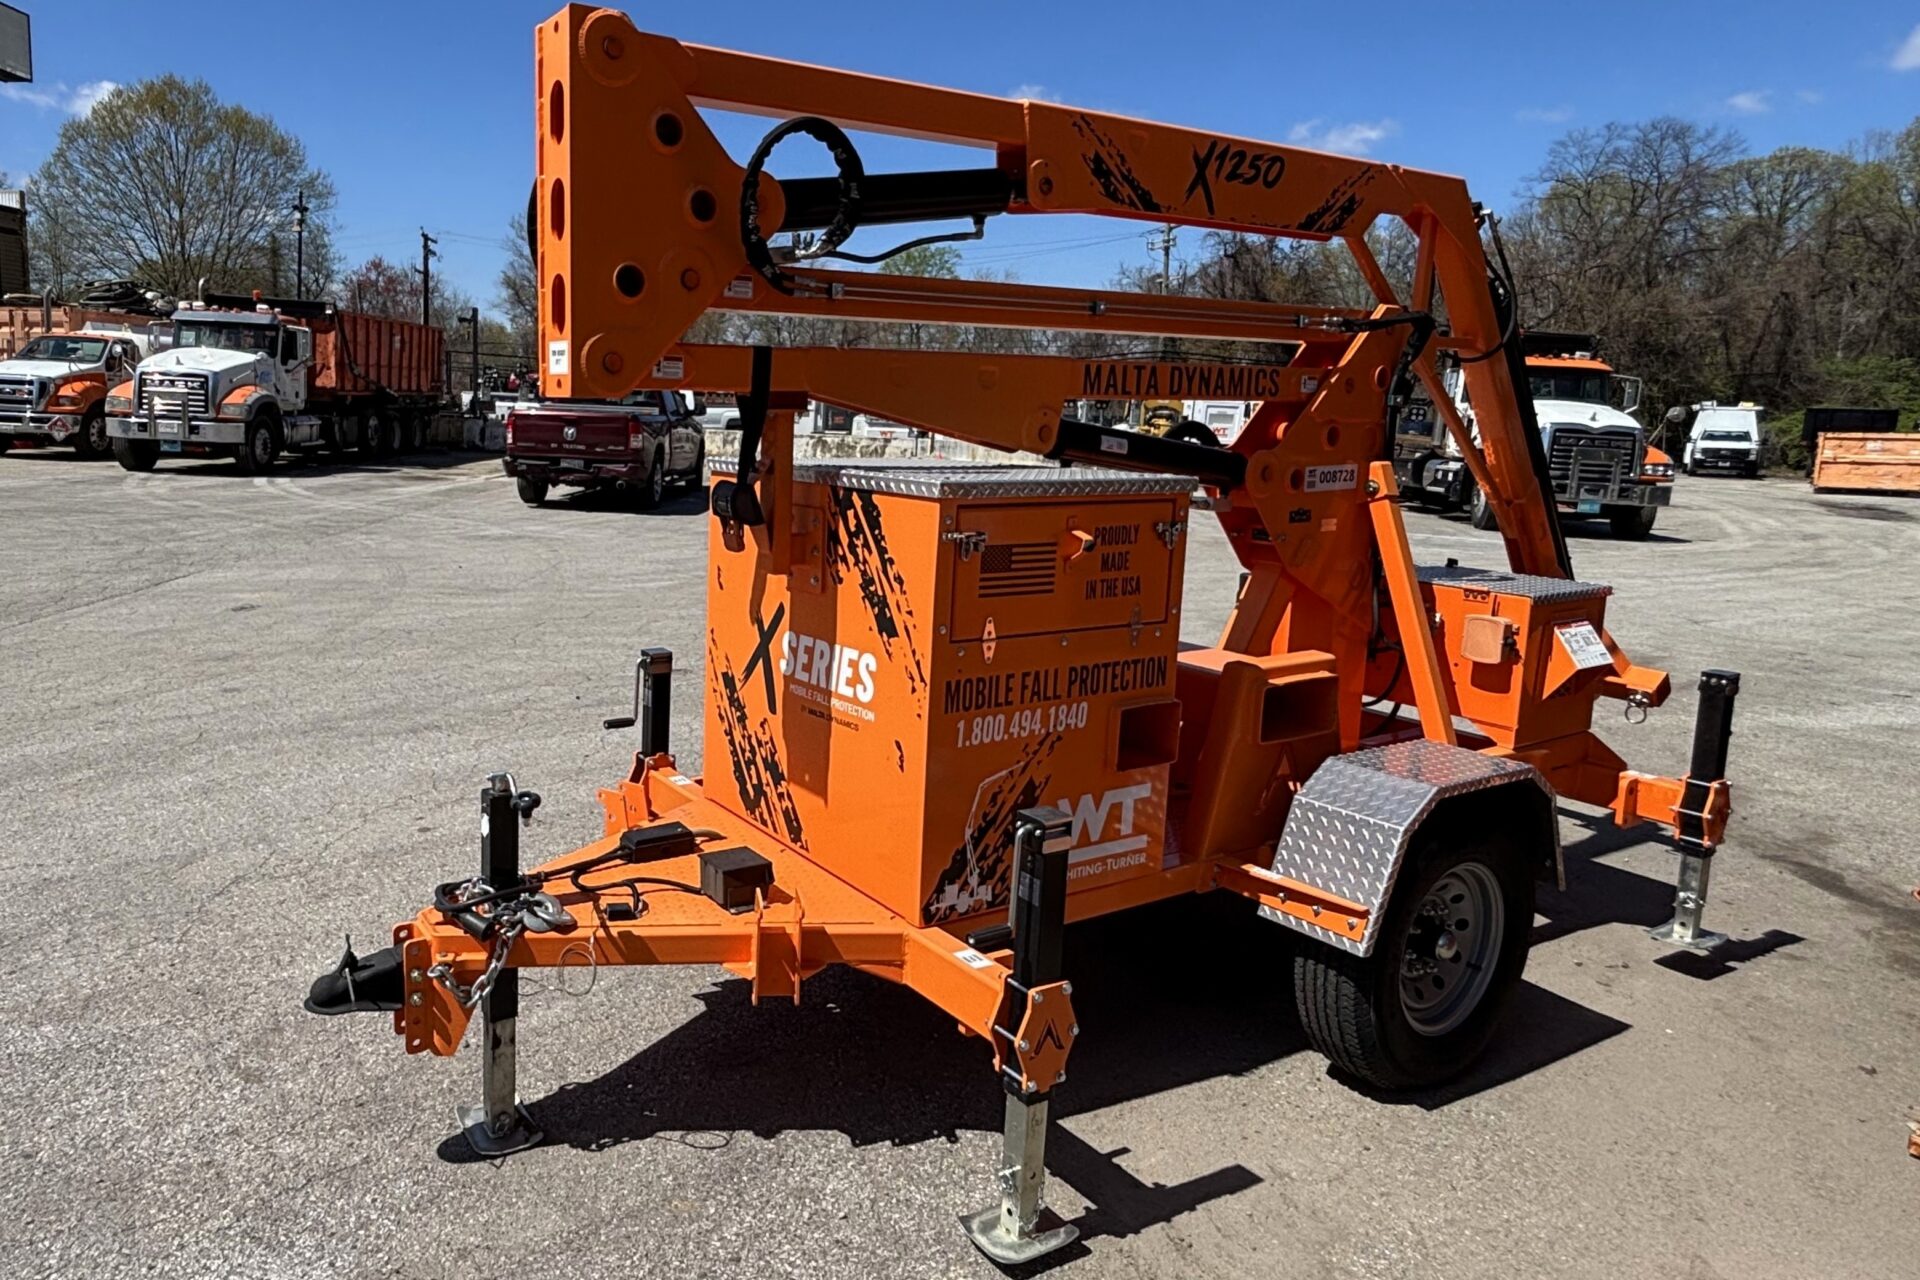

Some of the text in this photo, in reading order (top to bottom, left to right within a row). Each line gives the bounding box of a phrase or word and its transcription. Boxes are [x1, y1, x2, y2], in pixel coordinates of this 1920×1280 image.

[1183, 139, 1286, 216] X1250
[145, 379, 201, 389] MACK
[1083, 364, 1160, 396] MALTA
[1167, 366, 1280, 398] DYNAMICS
[1319, 469, 1356, 485] 008728
[1094, 524, 1140, 546] PROUDLY
[1100, 551, 1131, 573] MADE
[1085, 576, 1141, 600] IN THE USA
[739, 600, 877, 715] X SERIES
[944, 656, 1169, 715] MOBILE FALL PROTECTION
[831, 697, 875, 723] PROTECTION
[956, 701, 1088, 749] 1.800.494.1840
[1066, 852, 1147, 881] HITING-TURNER
